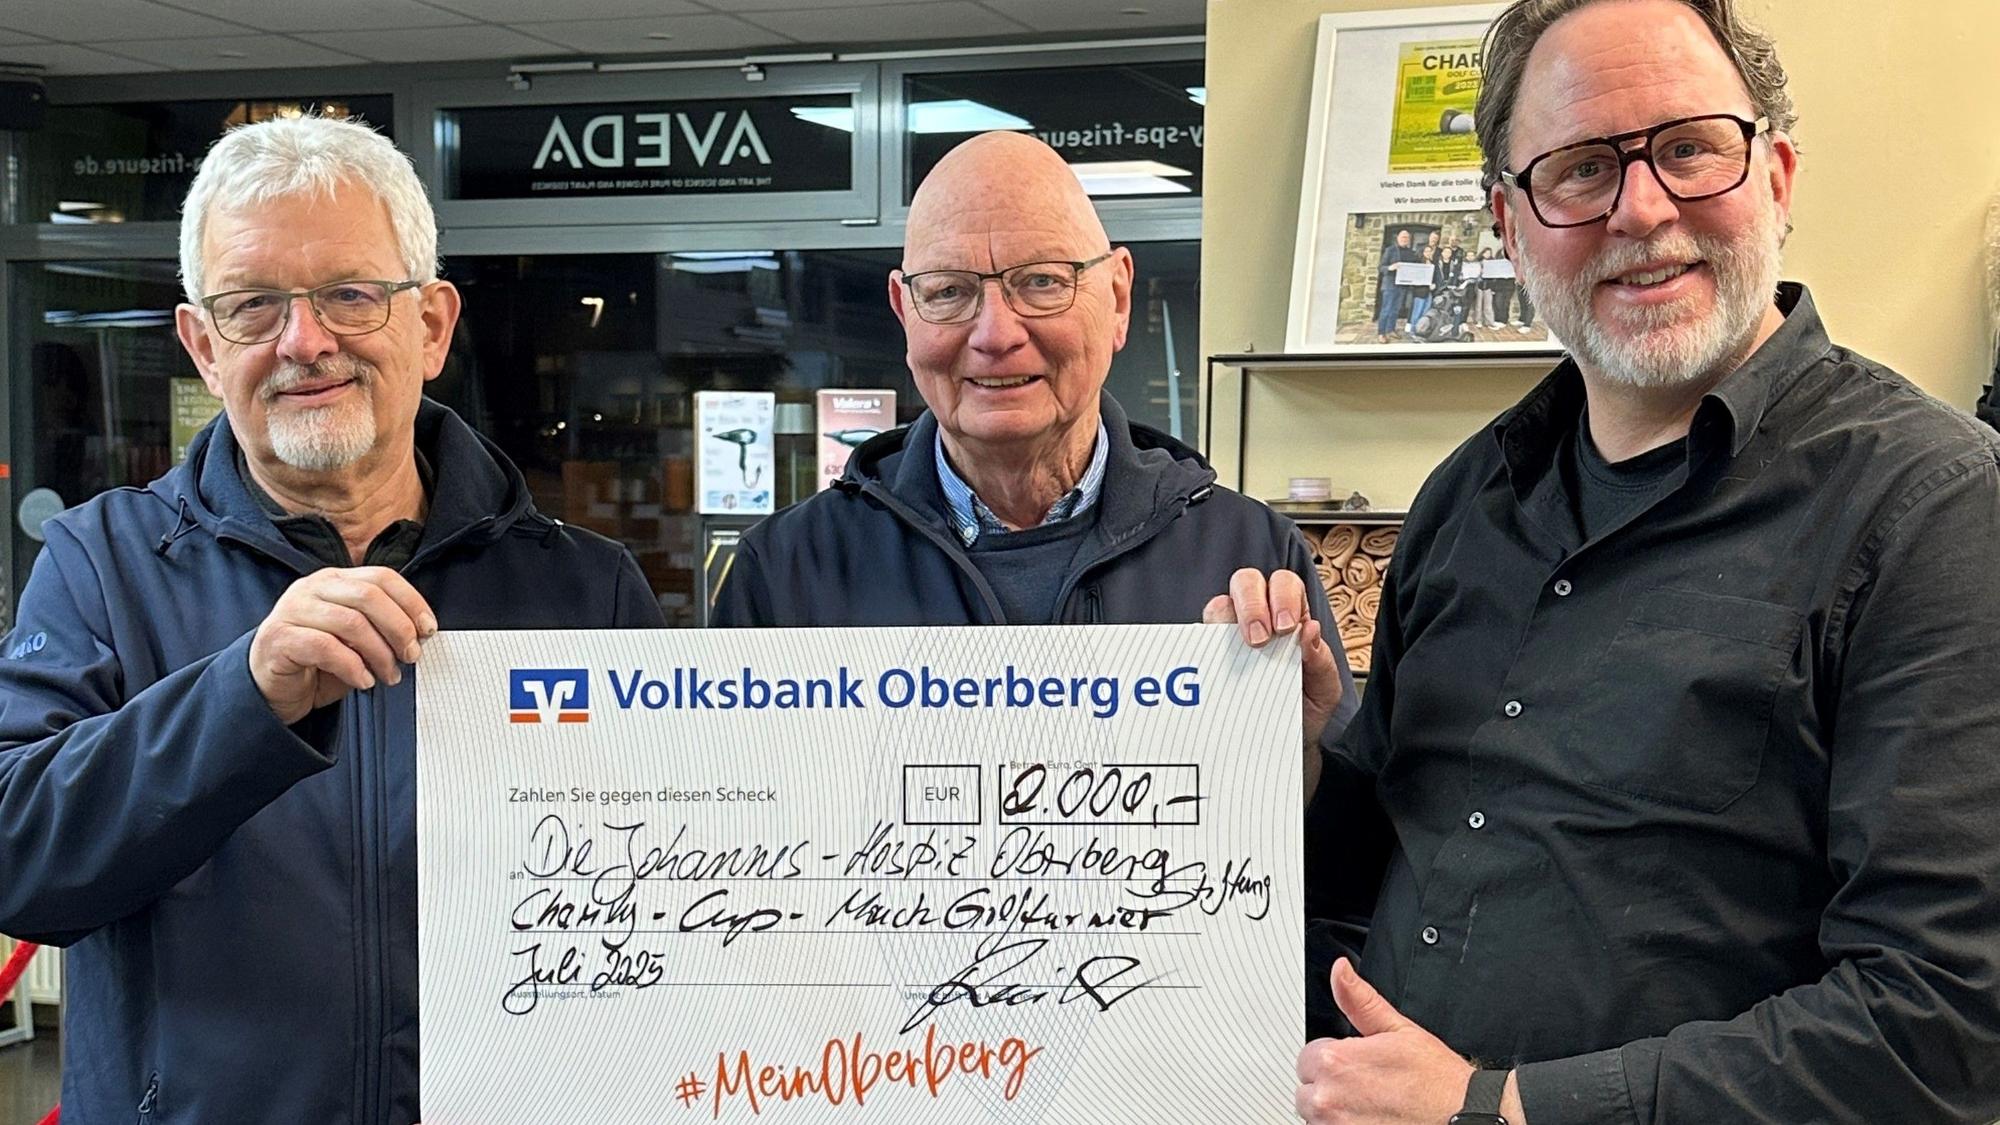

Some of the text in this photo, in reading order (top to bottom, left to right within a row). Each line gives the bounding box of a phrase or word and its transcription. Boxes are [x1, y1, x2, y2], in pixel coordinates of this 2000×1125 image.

[608, 666, 1200, 718] Volksbank Oberberg eG
[509, 786, 776, 805] Zahlen Sie gegen diesen Scheck
[925, 787, 961, 802] EUR
[509, 871, 525, 880] an
[592, 949, 665, 992] 2025
[590, 989, 621, 999] Datum
[676, 1023, 1044, 1120] #MeinOberberg
